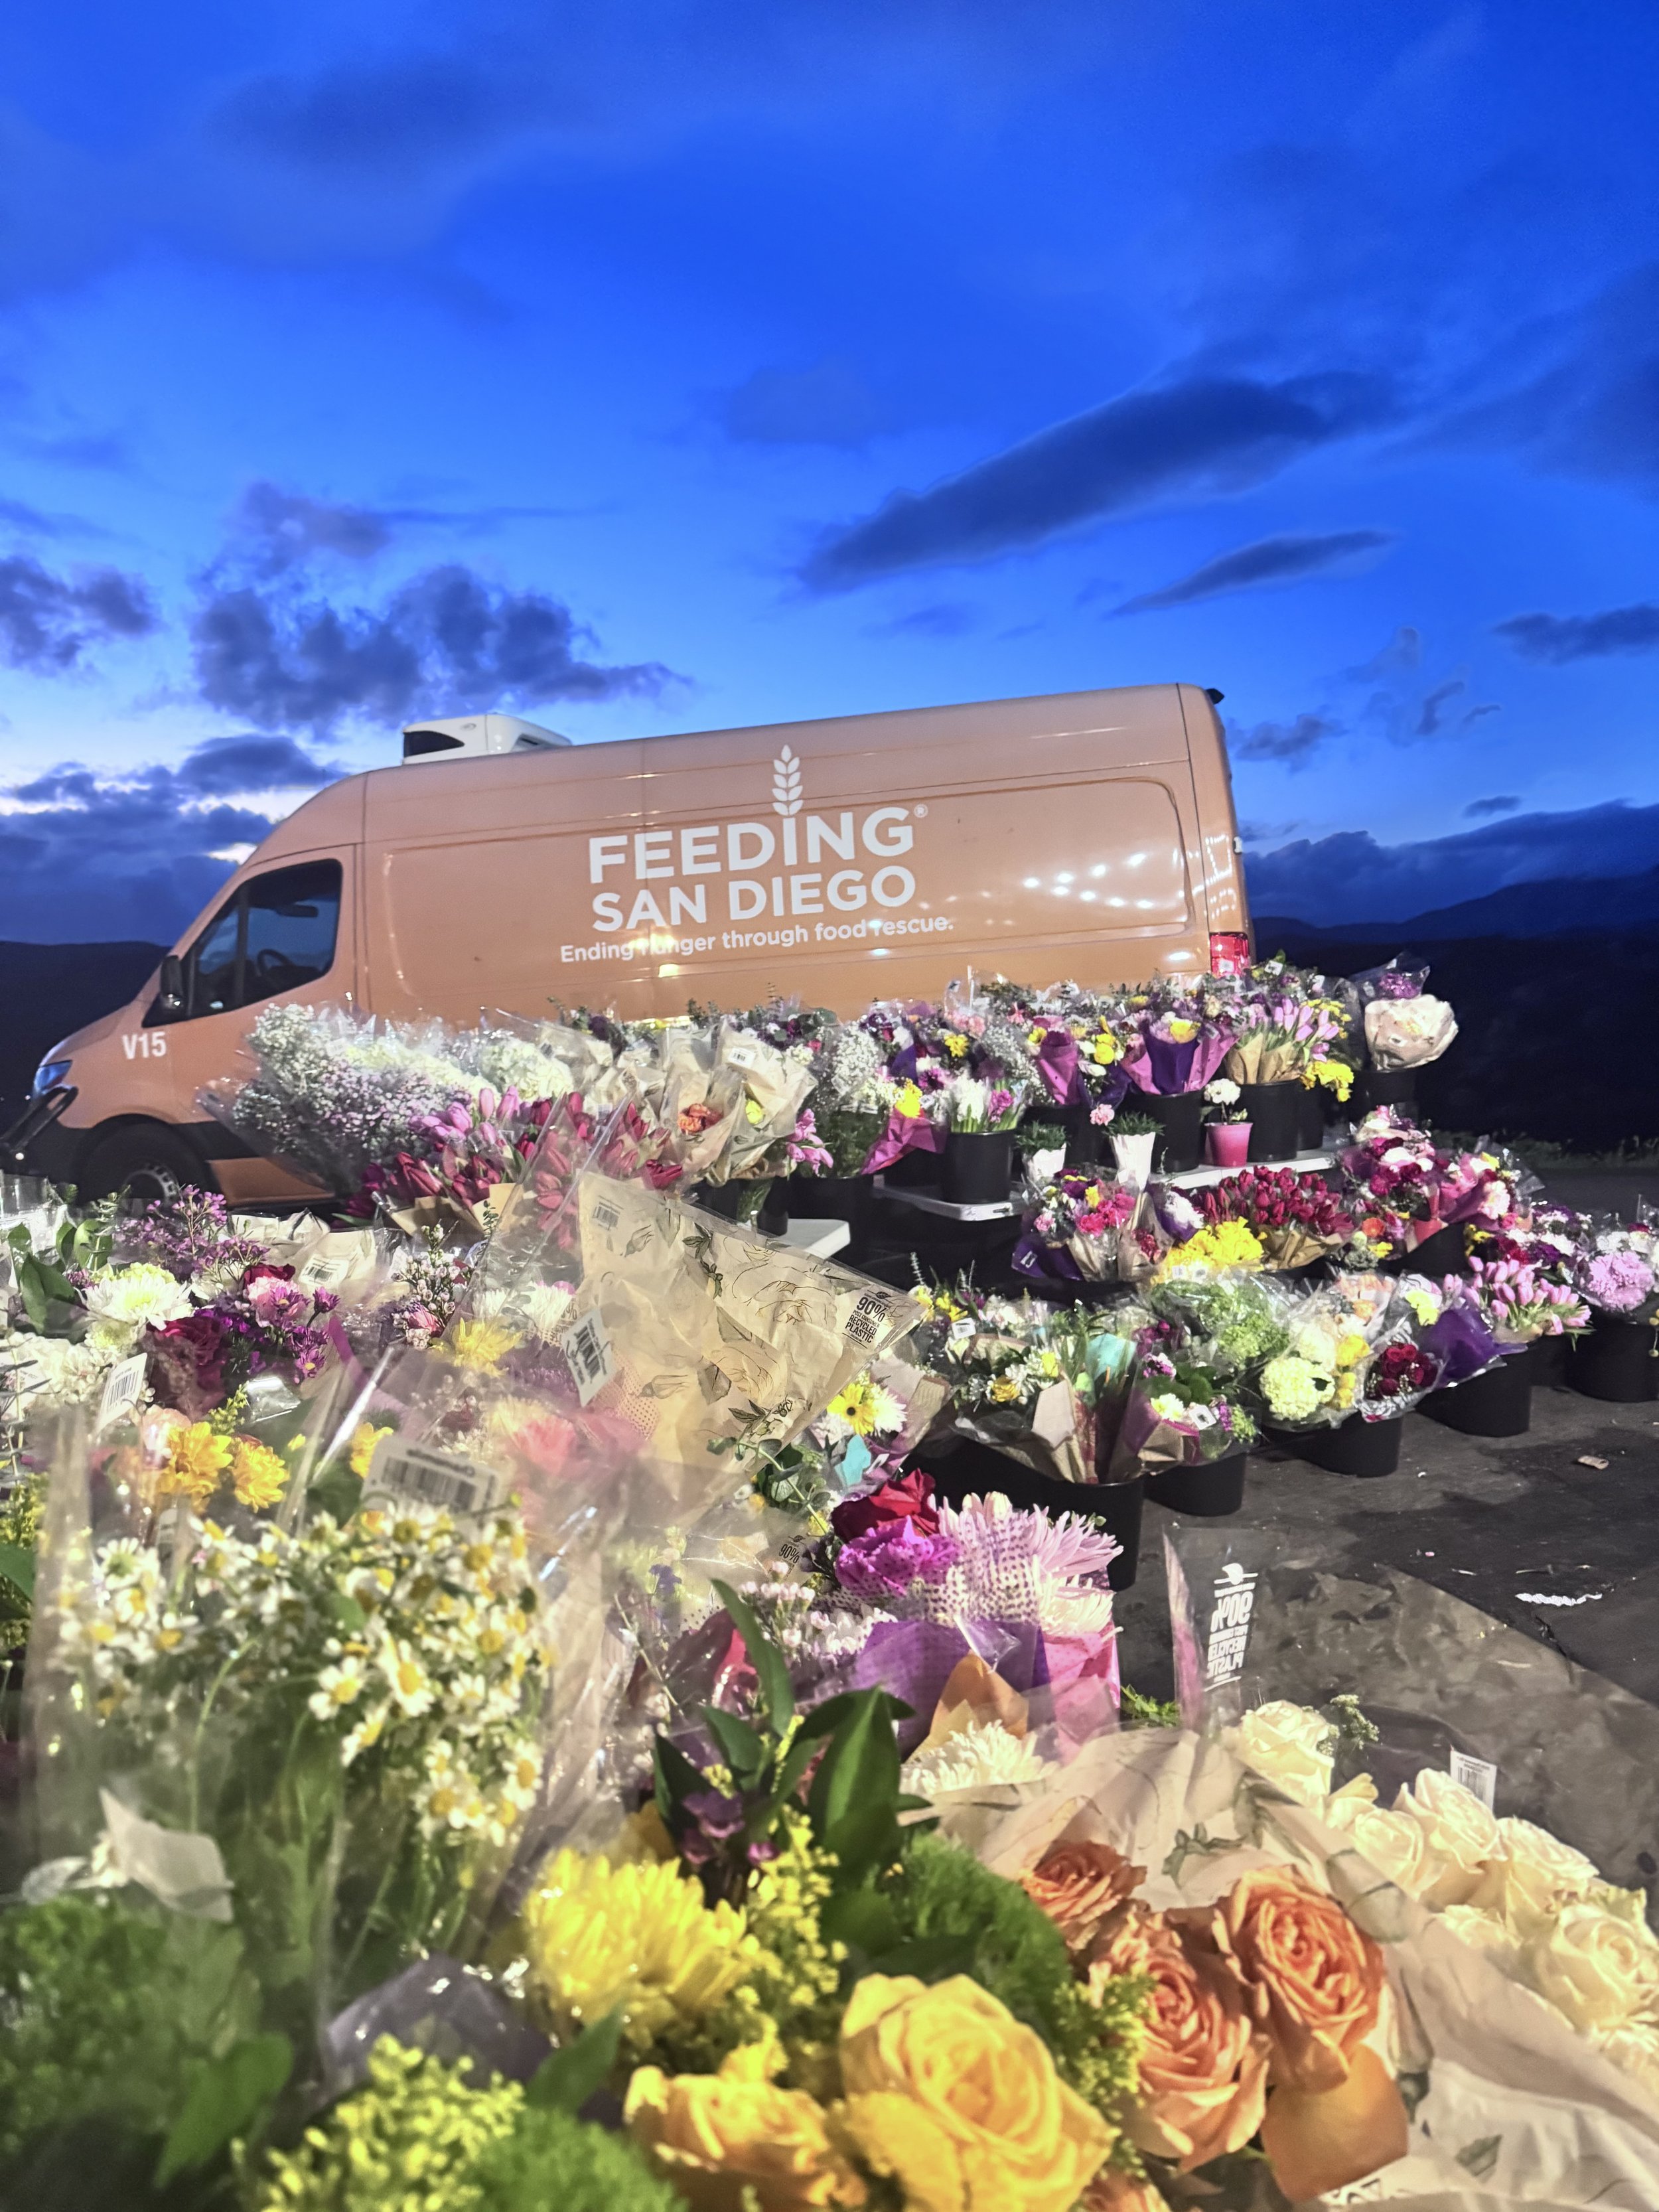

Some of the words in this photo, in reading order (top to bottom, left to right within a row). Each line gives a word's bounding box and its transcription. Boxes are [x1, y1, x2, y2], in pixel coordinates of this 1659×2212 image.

[589, 806, 914, 884] FEEDING
[592, 883, 707, 932] SAN
[729, 865, 916, 921] DIEGO
[560, 941, 634, 962] Ending
[722, 924, 808, 948] through
[814, 919, 867, 940] food
[873, 916, 954, 937] rescue.
[122, 1031, 167, 1060] V15
[856, 1296, 887, 1323] 90%
[845, 1322, 874, 1344] PLASTIC
[849, 1314, 877, 1336] RECYCLED
[778, 1543, 800, 1564] 90%
